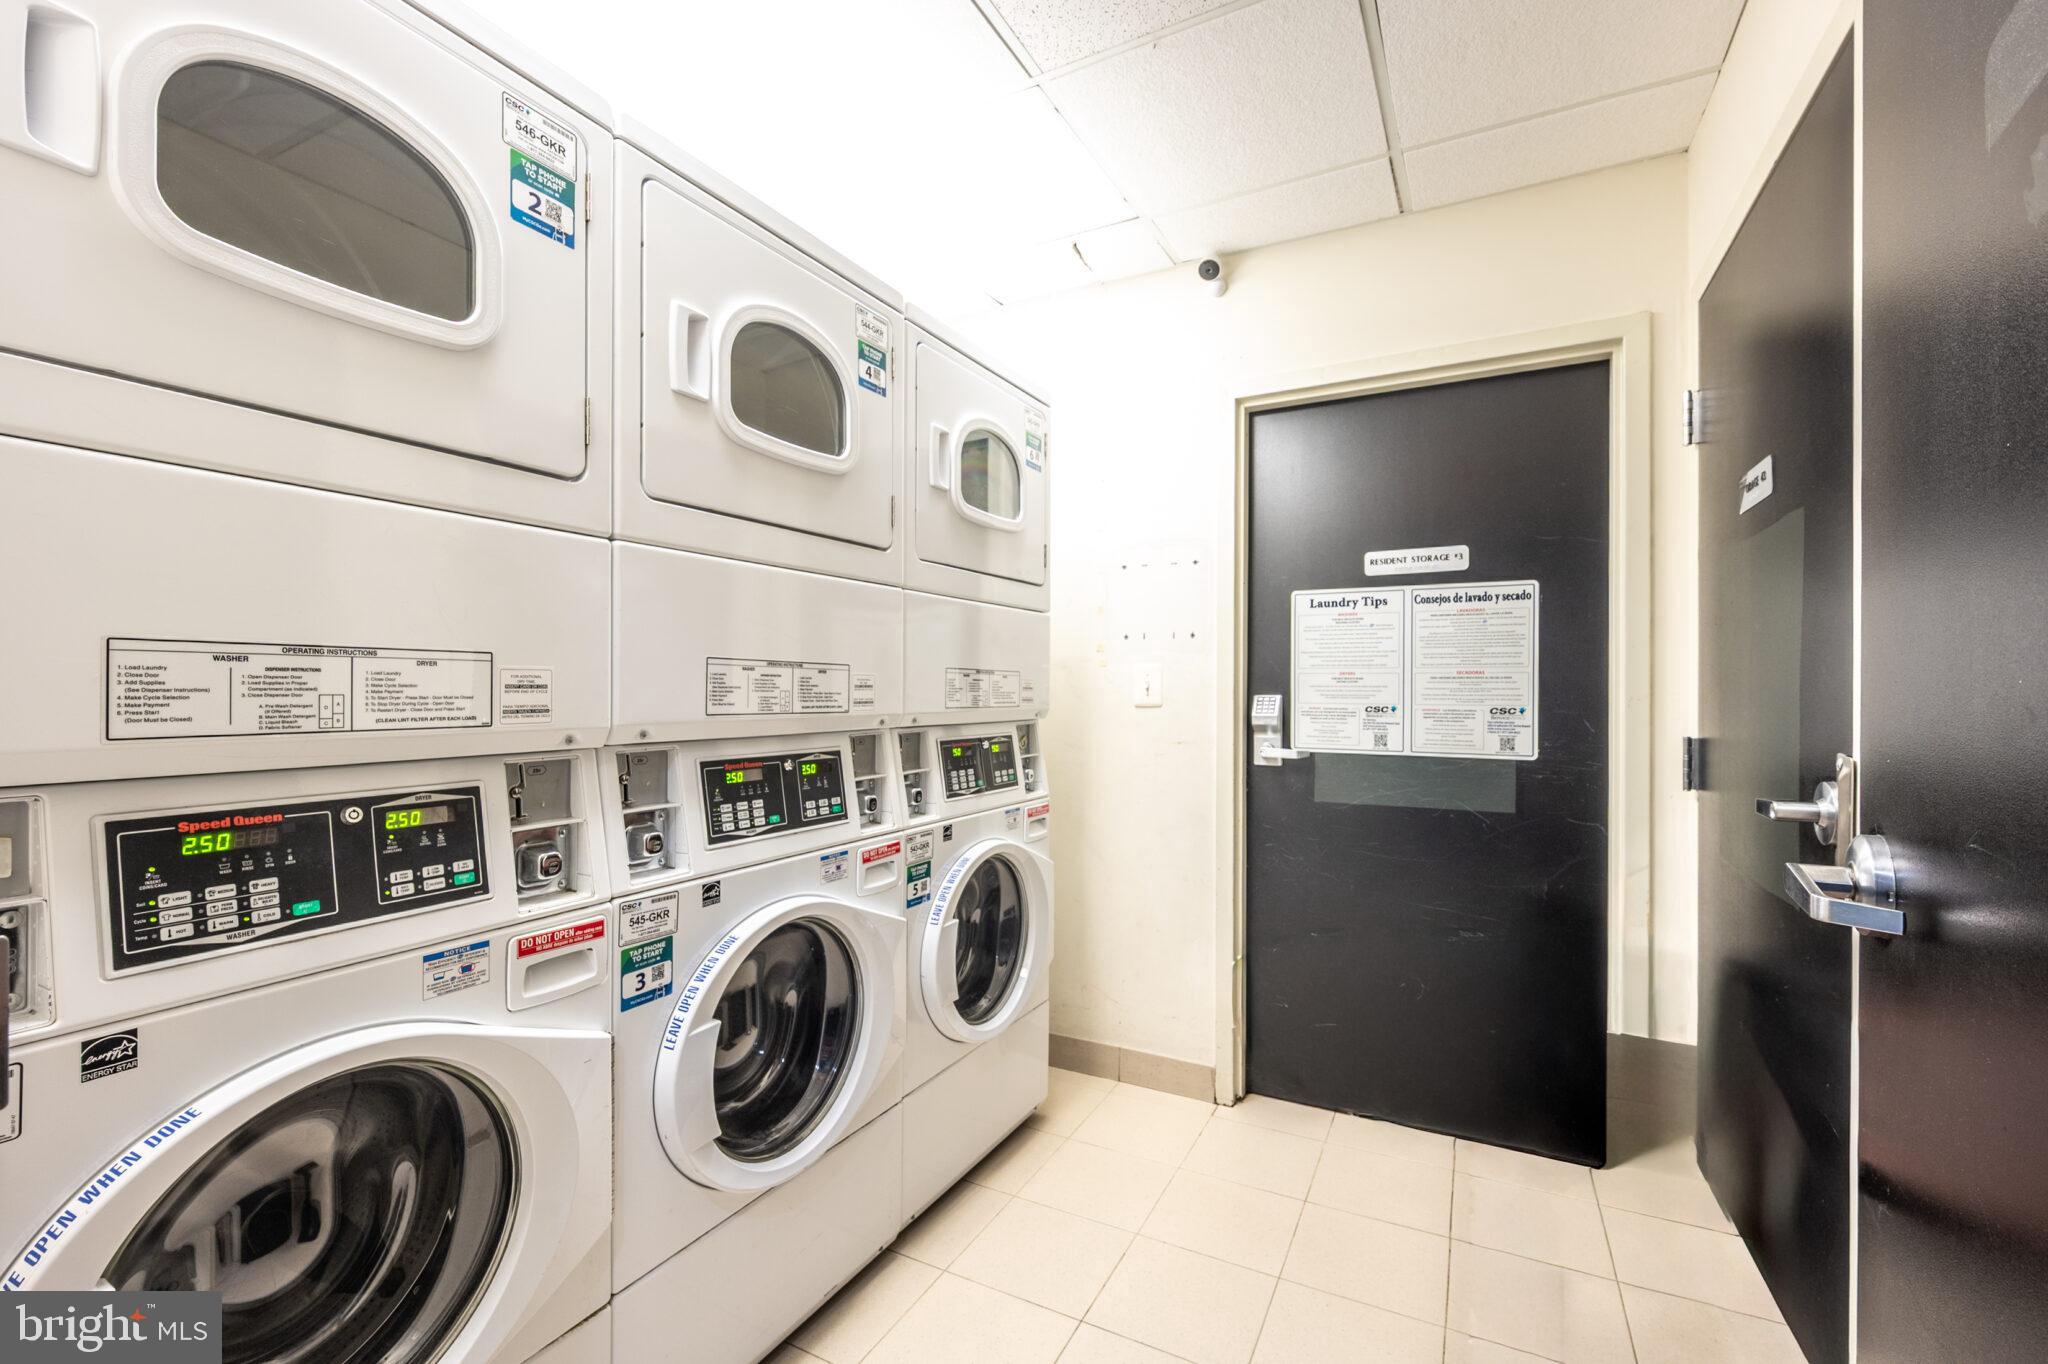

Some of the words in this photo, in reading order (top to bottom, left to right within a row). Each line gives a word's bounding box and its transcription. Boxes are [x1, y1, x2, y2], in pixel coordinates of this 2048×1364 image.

[516, 120, 566, 158] 546-GKR
[521, 158, 537, 170] TAP
[539, 168, 566, 188] PHONE
[524, 168, 536, 178] TO
[538, 175, 563, 193] START
[528, 191, 541, 216] 2
[866, 366, 872, 379] 4
[1370, 557, 1407, 565] RESIDENT
[1411, 554, 1450, 562] STORAGE
[1310, 597, 1358, 609] Laundry
[1362, 597, 1388, 608] Tips
[1415, 594, 1451, 606] Consejos
[1453, 593, 1462, 603] de
[1465, 592, 1493, 602] lavado
[1495, 594, 1500, 604] y
[1502, 590, 1531, 601] secado
[178, 817, 230, 833] Speed
[234, 814, 282, 826] Queen
[386, 811, 421, 829] 2.50
[182, 833, 230, 855] 2.50
[913, 883, 918, 896] 5
[622, 902, 637, 911] CSC
[930, 904, 944, 925] LEAVE
[938, 886, 951, 902] OPEN
[629, 910, 670, 927] 545-GKR
[226, 930, 256, 940] WASHER
[521, 938, 533, 948] DO
[536, 933, 552, 945] NOT
[554, 928, 574, 940] OPEN
[444, 946, 470, 956] NOTICE
[629, 948, 642, 957] TAP
[644, 941, 666, 952] PHONE
[643, 948, 663, 960] START
[635, 972, 646, 992] 3
[664, 1016, 685, 1051] LEAVE
[678, 985, 700, 1013] OPEN
[694, 956, 720, 983] WHEN
[715, 935, 740, 955] DONE
[82, 1068, 115, 1082] ENERGY
[116, 1060, 138, 1072] STAR
[24, 1210, 77, 1266] OPEN
[77, 1150, 142, 1205] WHEN
[143, 1107, 202, 1148] DONE
